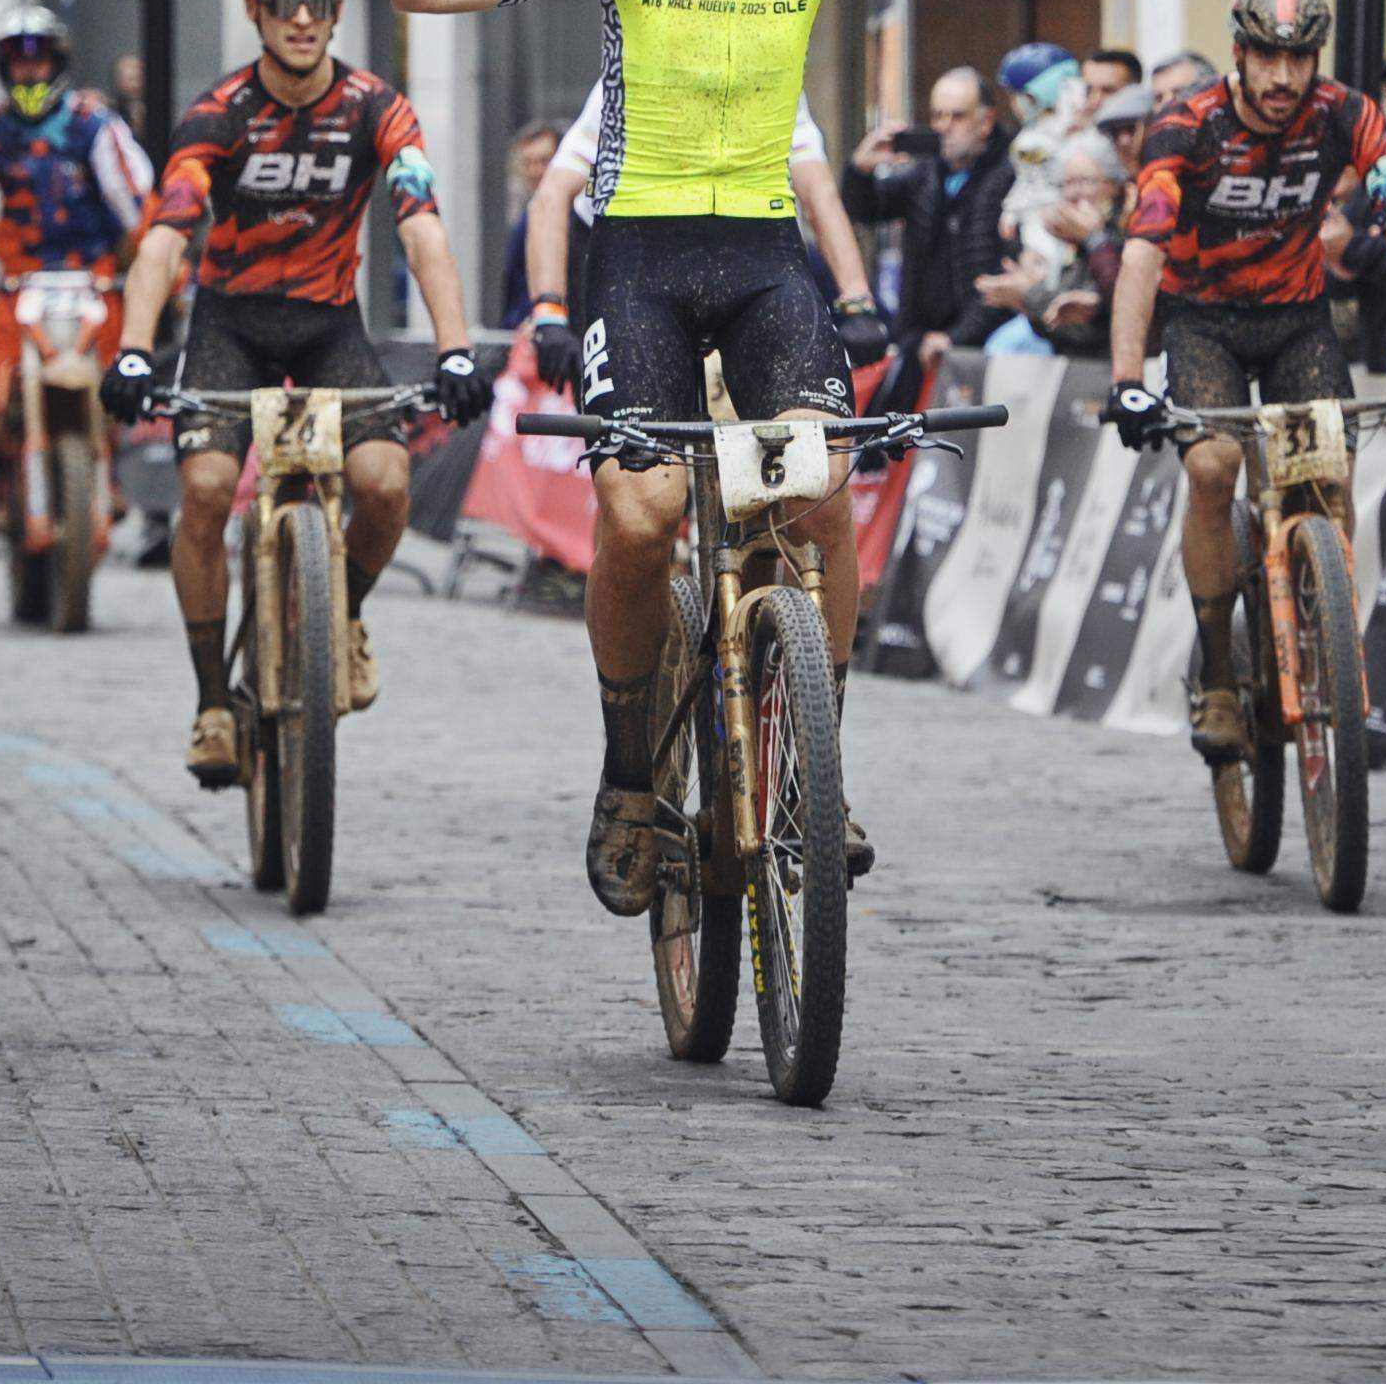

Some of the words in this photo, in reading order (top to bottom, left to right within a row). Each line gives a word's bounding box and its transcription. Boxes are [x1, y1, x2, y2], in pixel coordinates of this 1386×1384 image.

[699, 0, 737, 13] HUELVA
[741, 2, 766, 15] 2025
[236, 152, 352, 192] BH
[1209, 172, 1321, 211] BH
[582, 317, 614, 406] BH
[761, 448, 785, 488] 6
[747, 882, 765, 994] MAXXIS
